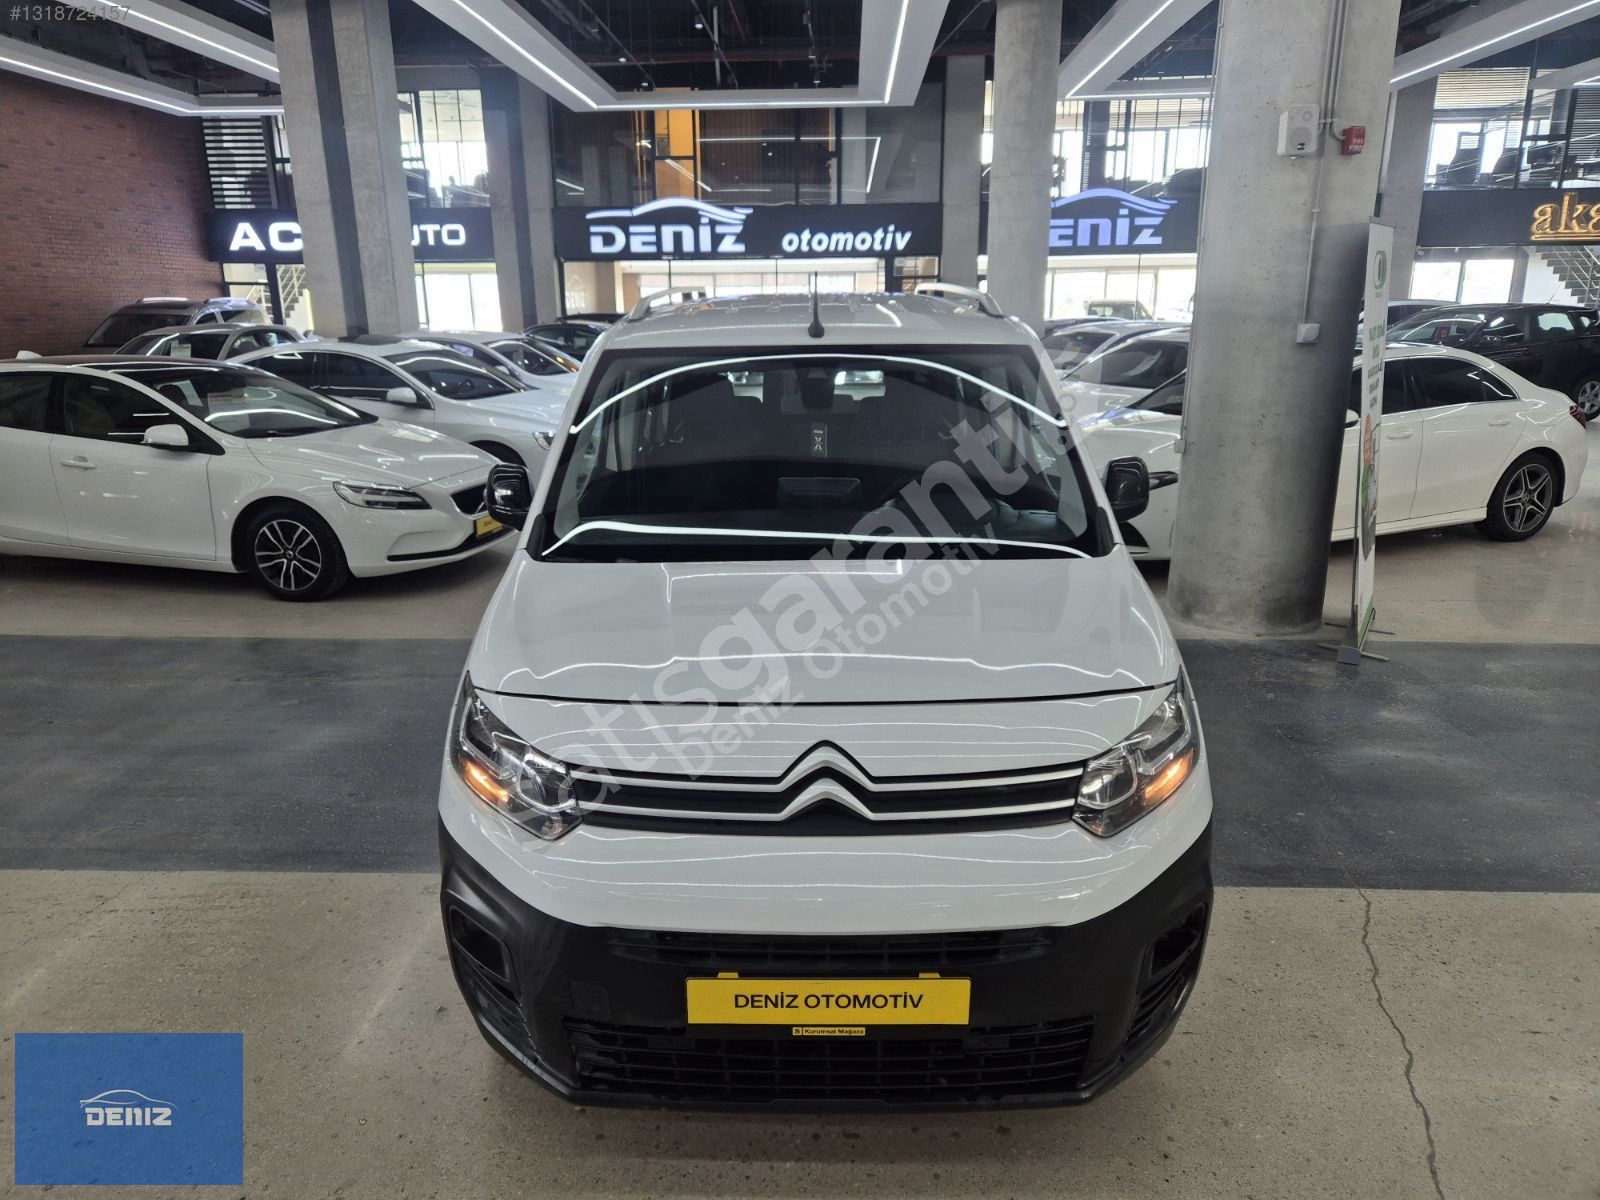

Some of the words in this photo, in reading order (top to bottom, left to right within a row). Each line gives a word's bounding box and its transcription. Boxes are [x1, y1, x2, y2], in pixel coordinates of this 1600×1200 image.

[781, 224, 913, 252] otomotiv
[734, 992, 799, 1009] DENİZ
[804, 992, 924, 1009] OTOMOTİV
